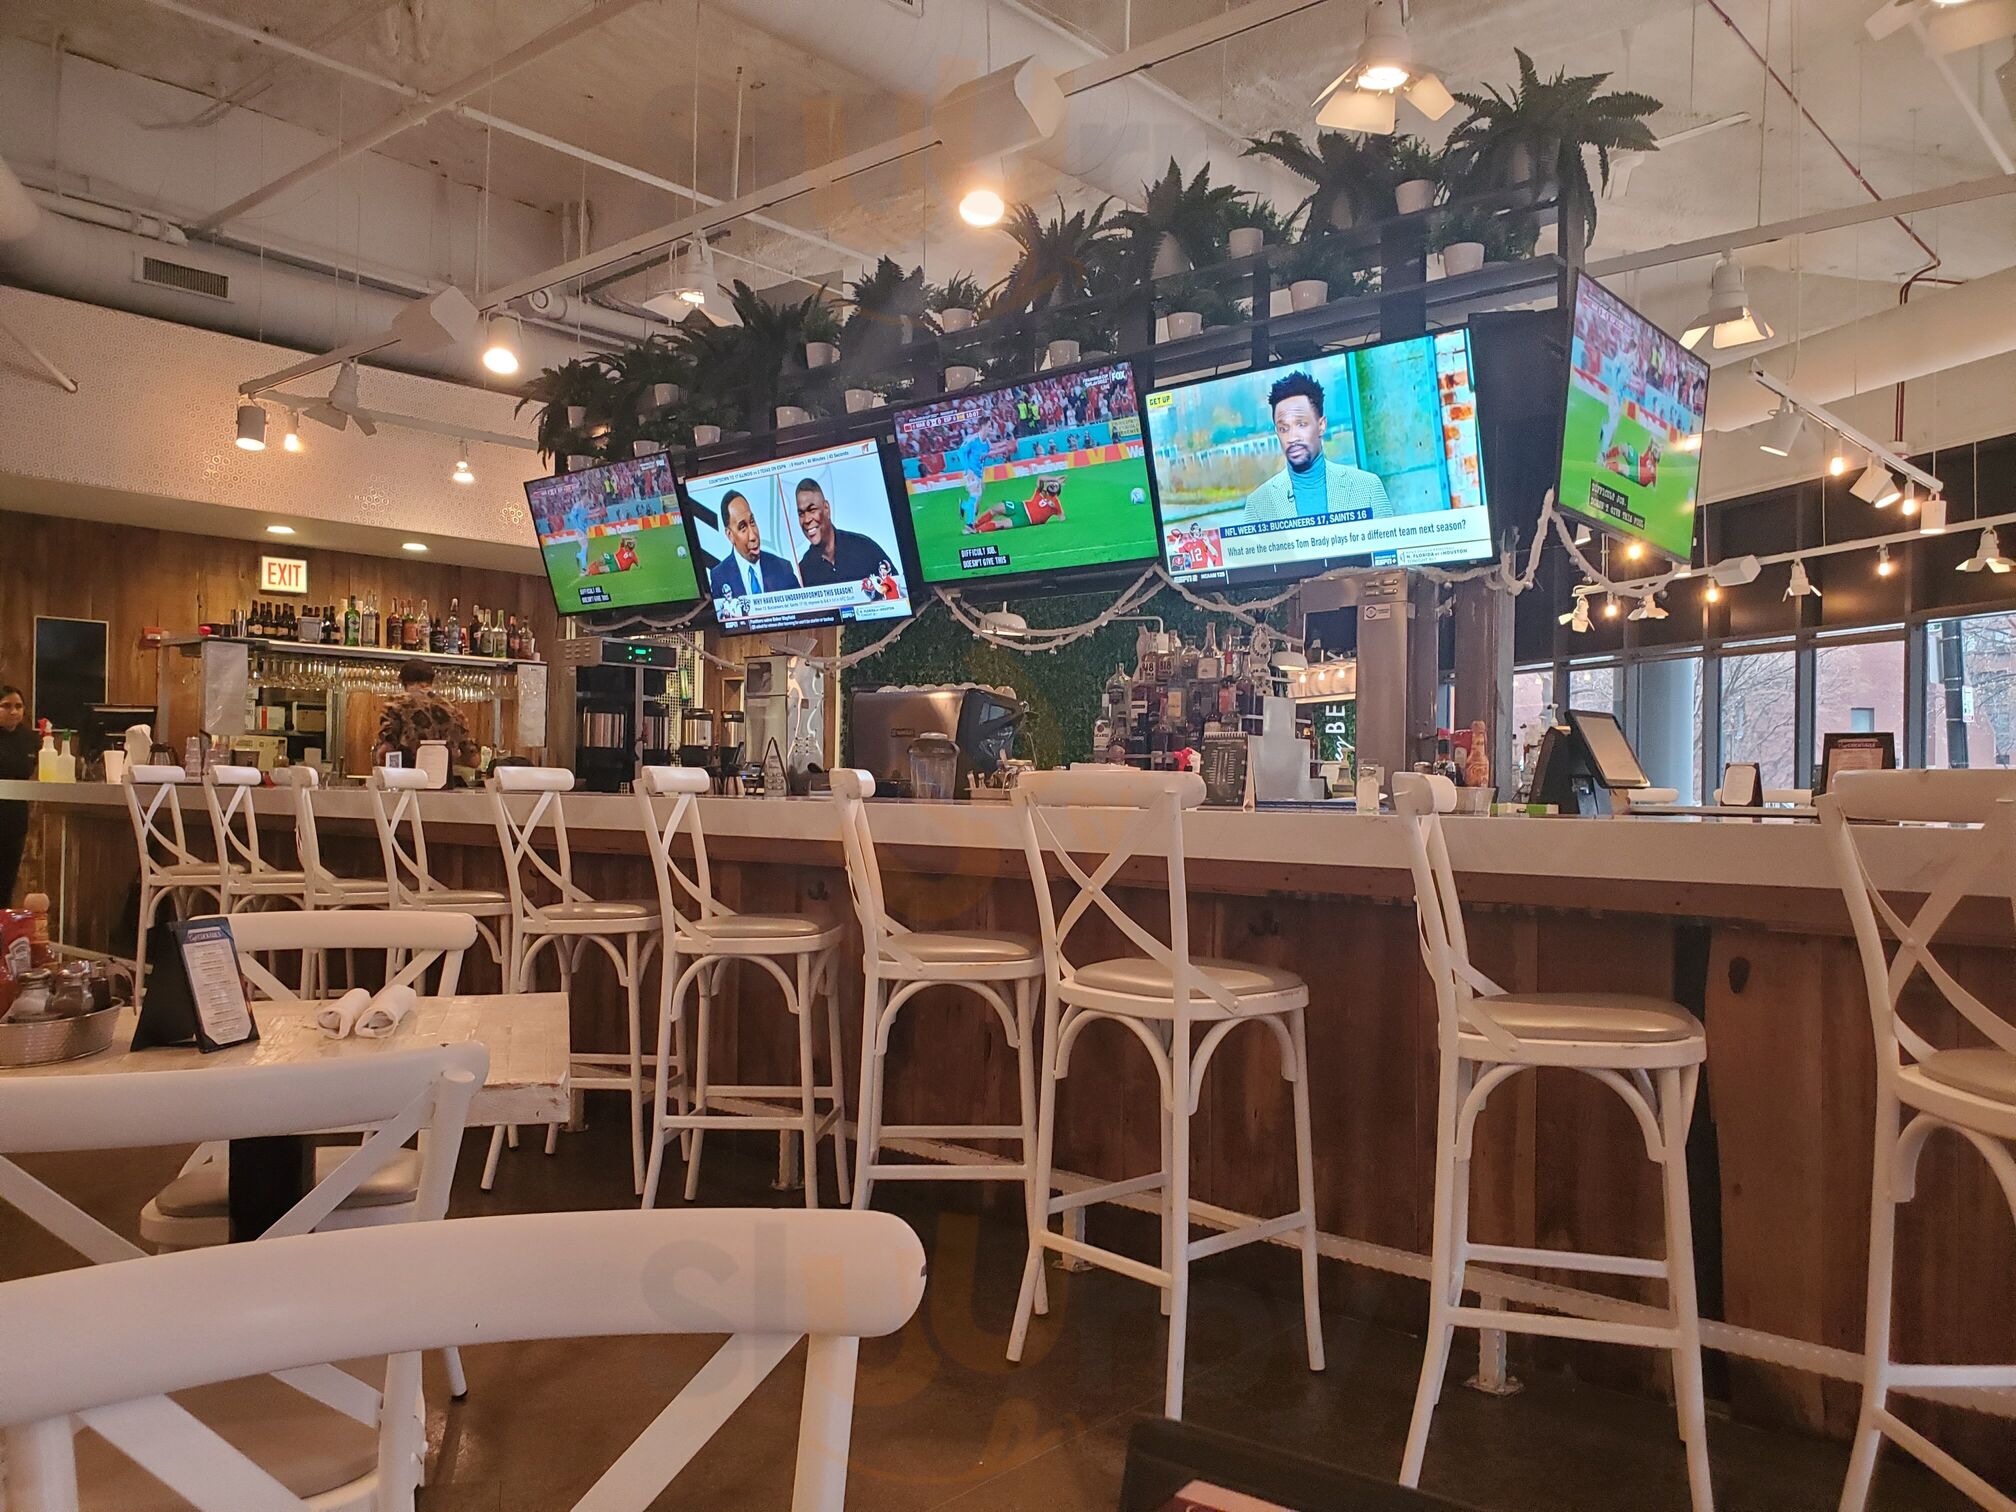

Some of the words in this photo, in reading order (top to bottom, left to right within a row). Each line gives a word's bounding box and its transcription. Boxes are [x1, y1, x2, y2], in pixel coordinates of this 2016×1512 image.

[1112, 370, 1126, 381] FOX
[1224, 528, 1238, 537] NFL
[1238, 526, 1257, 535] WEEK
[1258, 524, 1270, 532] 13:
[1270, 517, 1316, 531] BUCCANEERS
[1317, 515, 1329, 524] 17,
[1330, 512, 1356, 522] SAINTS
[1357, 510, 1367, 519] 16
[1228, 546, 1244, 557] What
[1246, 546, 1256, 554] are
[1256, 544, 1267, 553] the
[1268, 541, 1295, 552] chances
[1296, 538, 1310, 548] Tom
[1311, 536, 1330, 550] Brady
[1332, 534, 1348, 546] plays
[1350, 532, 1360, 542] for
[1360, 533, 1366, 541] a
[1367, 527, 1398, 540] different
[1398, 526, 1418, 537] team
[1418, 524, 1434, 534] next
[1436, 519, 1467, 532] season?
[961, 548, 986, 558] DIFFICULT
[963, 559, 982, 568] DOESN'T
[982, 558, 995, 566] GIVE
[995, 556, 1006, 564] THIS
[1190, 548, 1203, 562] 12
[268, 562, 302, 587] EXIT
[763, 596, 774, 604] HAVE
[774, 595, 784, 604] BUCS
[784, 592, 824, 602] UNDERPERFORMED
[824, 589, 834, 598] THIS
[834, 586, 854, 596] SEASON?
[1326, 705, 1346, 734] BE
